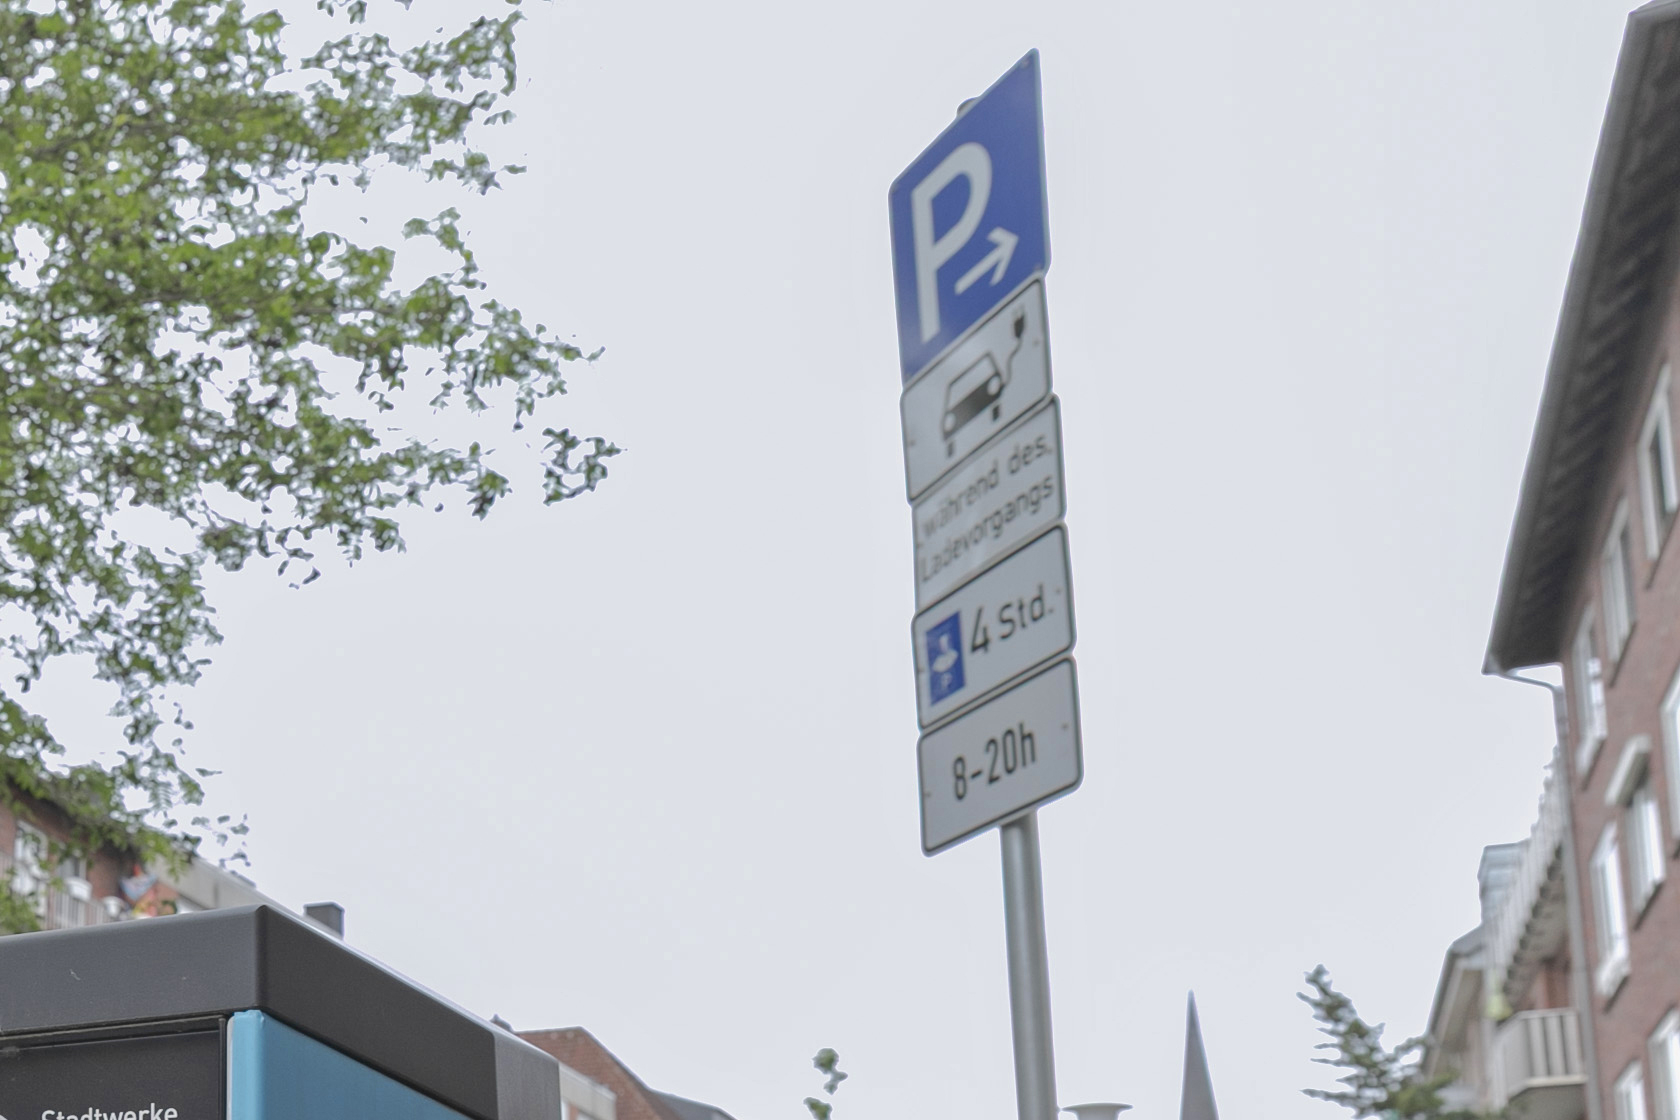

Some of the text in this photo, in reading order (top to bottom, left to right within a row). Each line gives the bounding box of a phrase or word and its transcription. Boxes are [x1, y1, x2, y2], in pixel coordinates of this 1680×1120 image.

[910, 142, 993, 345] P
[920, 475, 1054, 583] Ladevorgangs
[924, 434, 1048, 538] während des
[971, 583, 1054, 653] 4 Std.
[953, 723, 1036, 801] 8-20h
